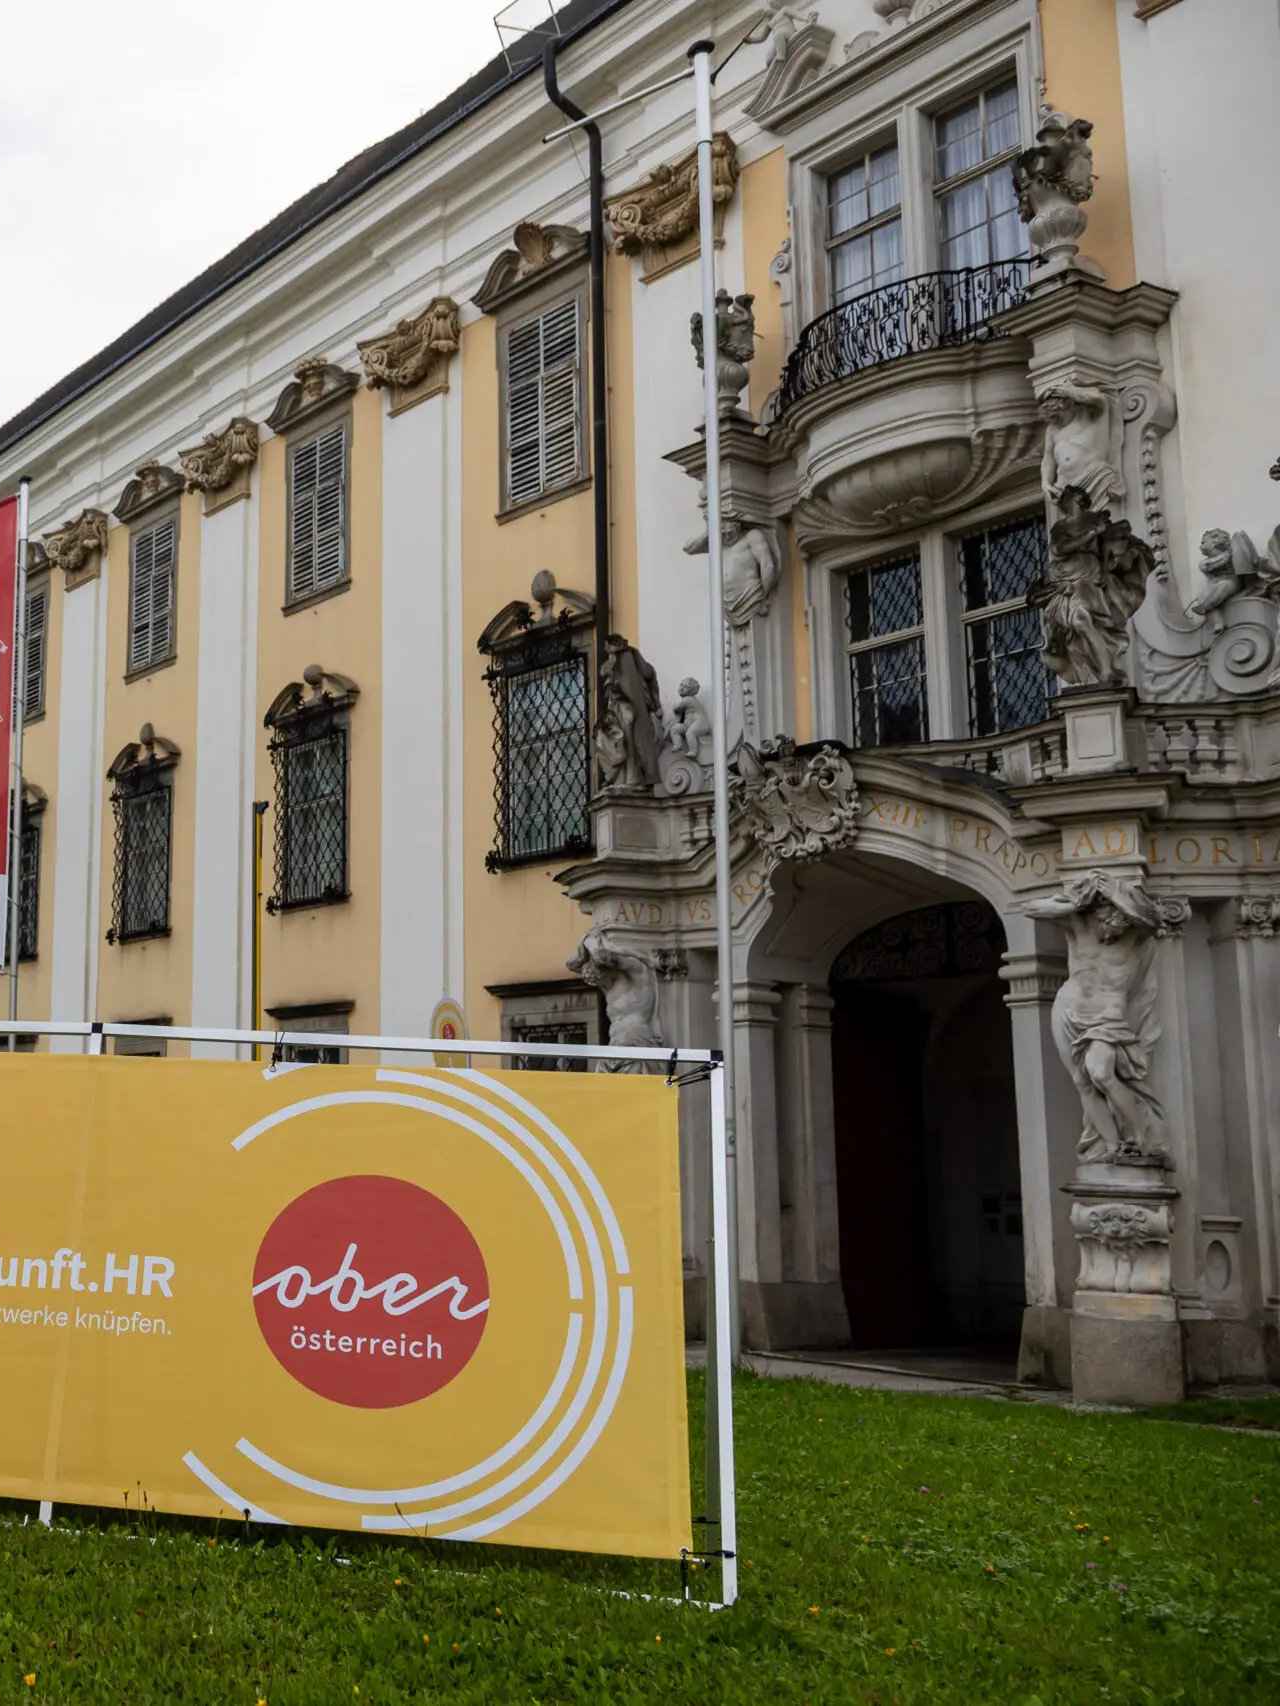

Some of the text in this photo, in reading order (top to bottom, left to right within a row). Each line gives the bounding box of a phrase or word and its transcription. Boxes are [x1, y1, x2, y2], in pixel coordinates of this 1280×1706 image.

[1073, 827, 1280, 864] AD LORI
[253, 1243, 489, 1320] ober
[75, 1307, 172, 1336] knüpfen.
[290, 1325, 442, 1359] österreich
